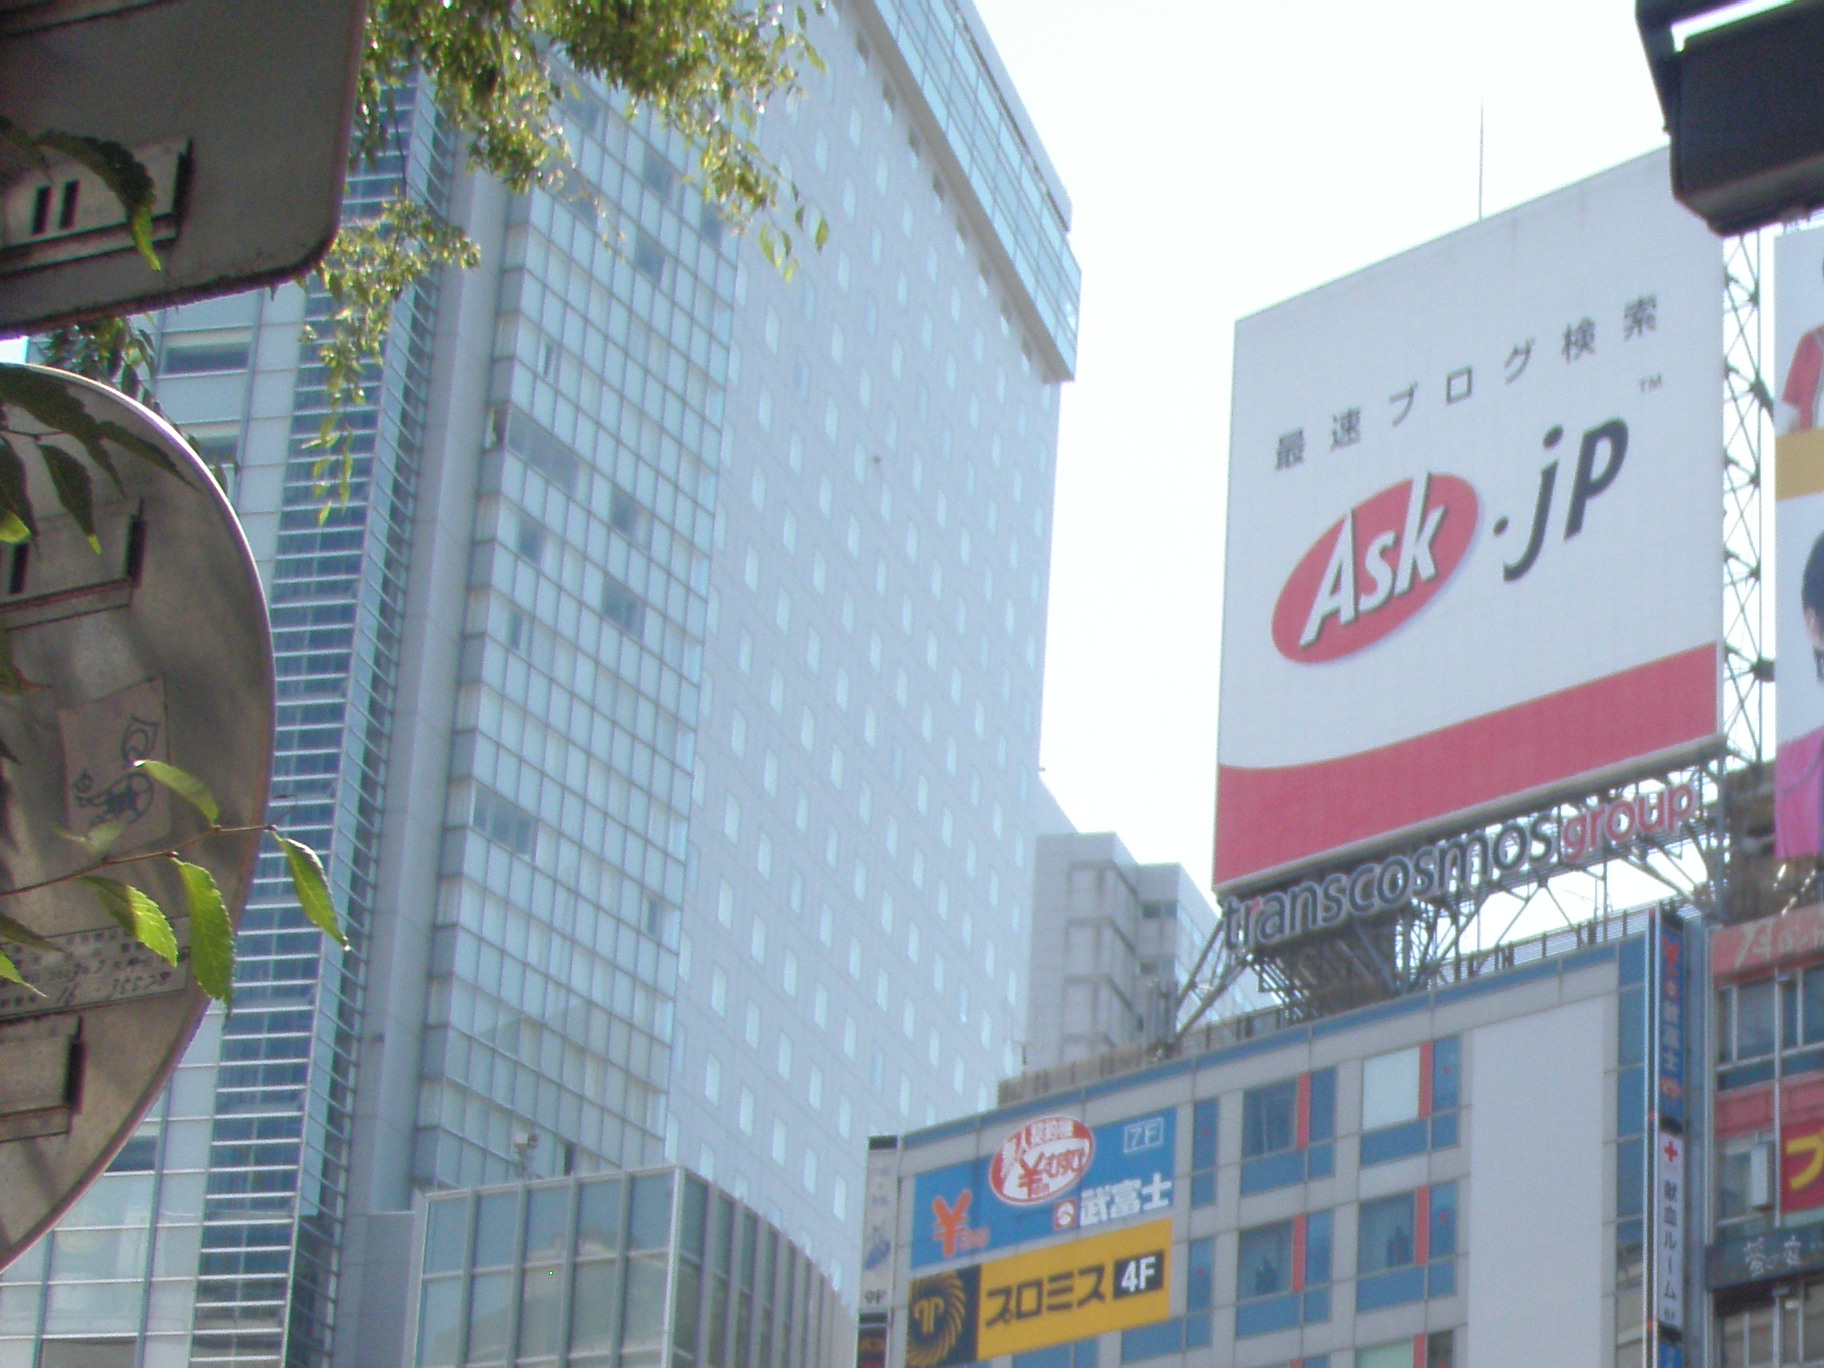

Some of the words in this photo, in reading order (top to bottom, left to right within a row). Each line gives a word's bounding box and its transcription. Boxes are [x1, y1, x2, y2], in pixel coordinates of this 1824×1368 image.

[1275, 295, 1658, 472] 最速ブログ検索
[985, 1263, 1107, 1328] プロミス
[1120, 1256, 1157, 1292] 4F
